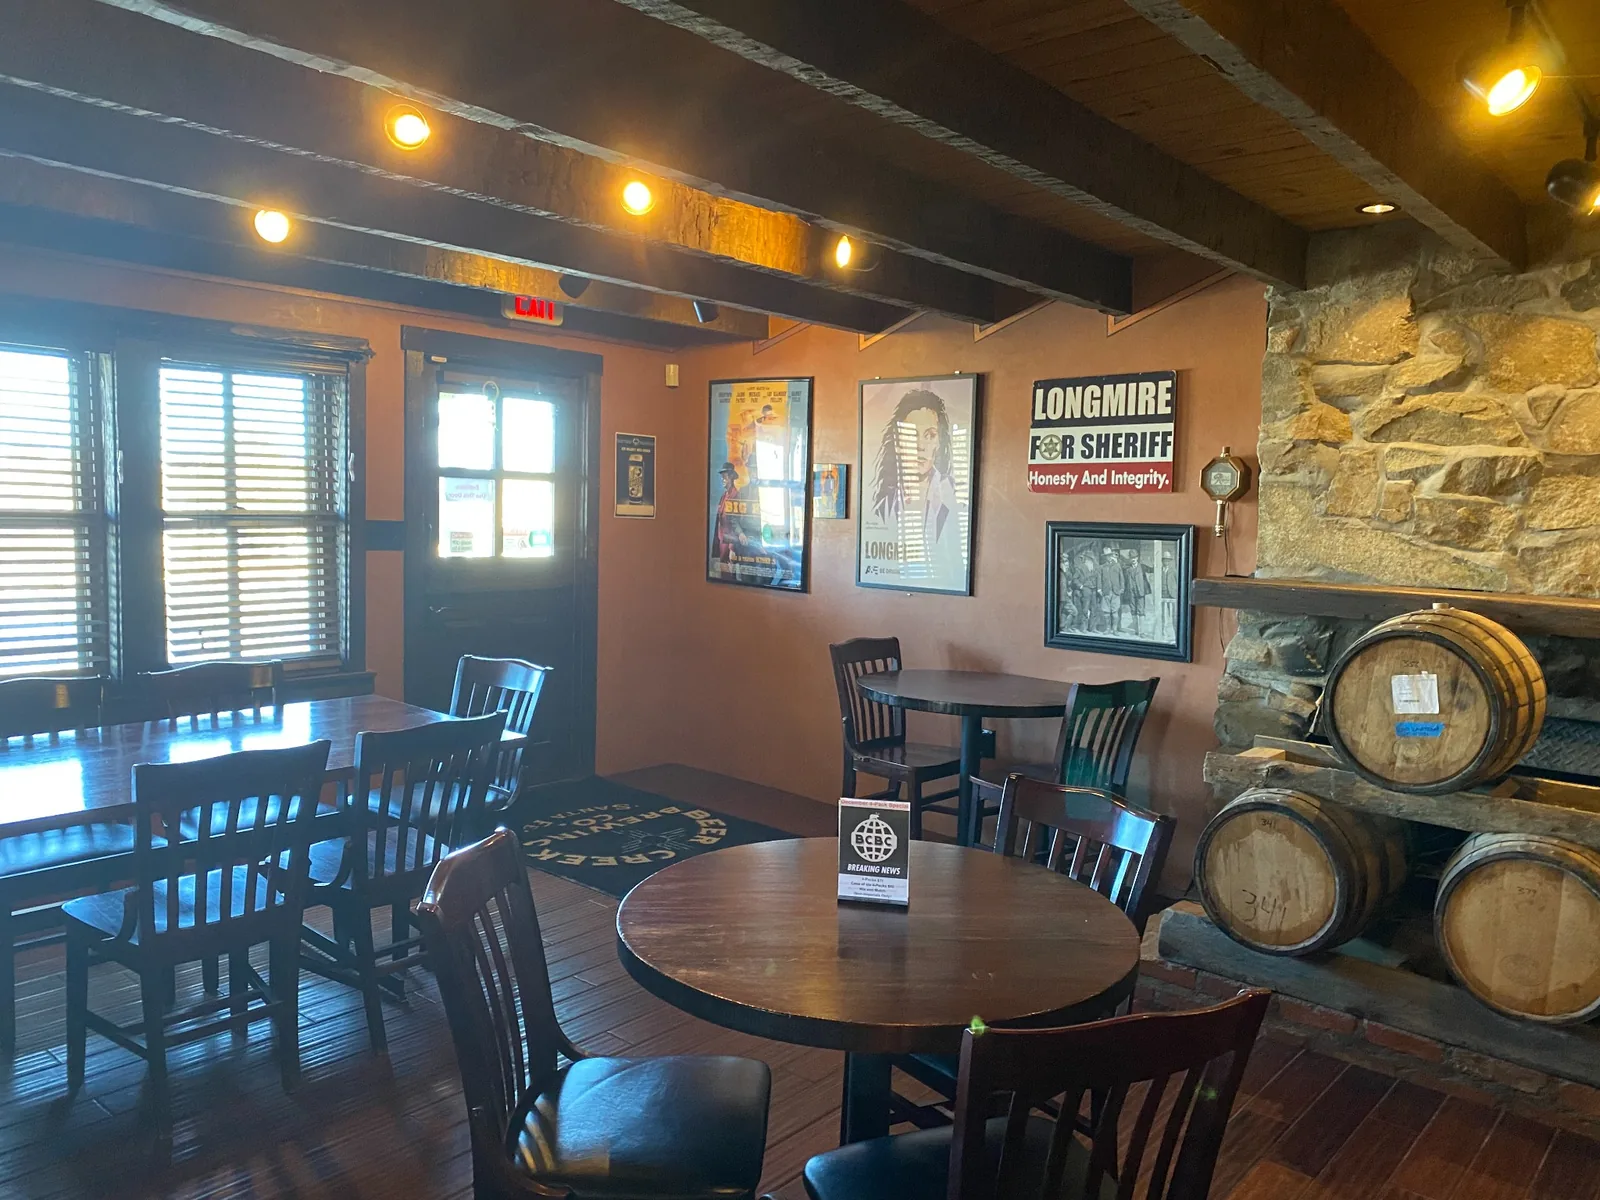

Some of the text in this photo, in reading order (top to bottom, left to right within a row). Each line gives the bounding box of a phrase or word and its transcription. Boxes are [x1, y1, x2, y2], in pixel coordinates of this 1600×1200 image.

[1034, 380, 1172, 420] LONGMIRE
[1080, 431, 1172, 459] SHERIFF
[1029, 468, 1170, 490] Honesty And Integrity.
[725, 500, 747, 513] BIG
[522, 806, 681, 847] BREWING
[681, 809, 728, 845] BEER
[855, 834, 893, 847] BCBC
[526, 849, 677, 866] CREEK
[847, 863, 901, 875] BREAKING NEWS
[1241, 889, 1287, 930] 341
